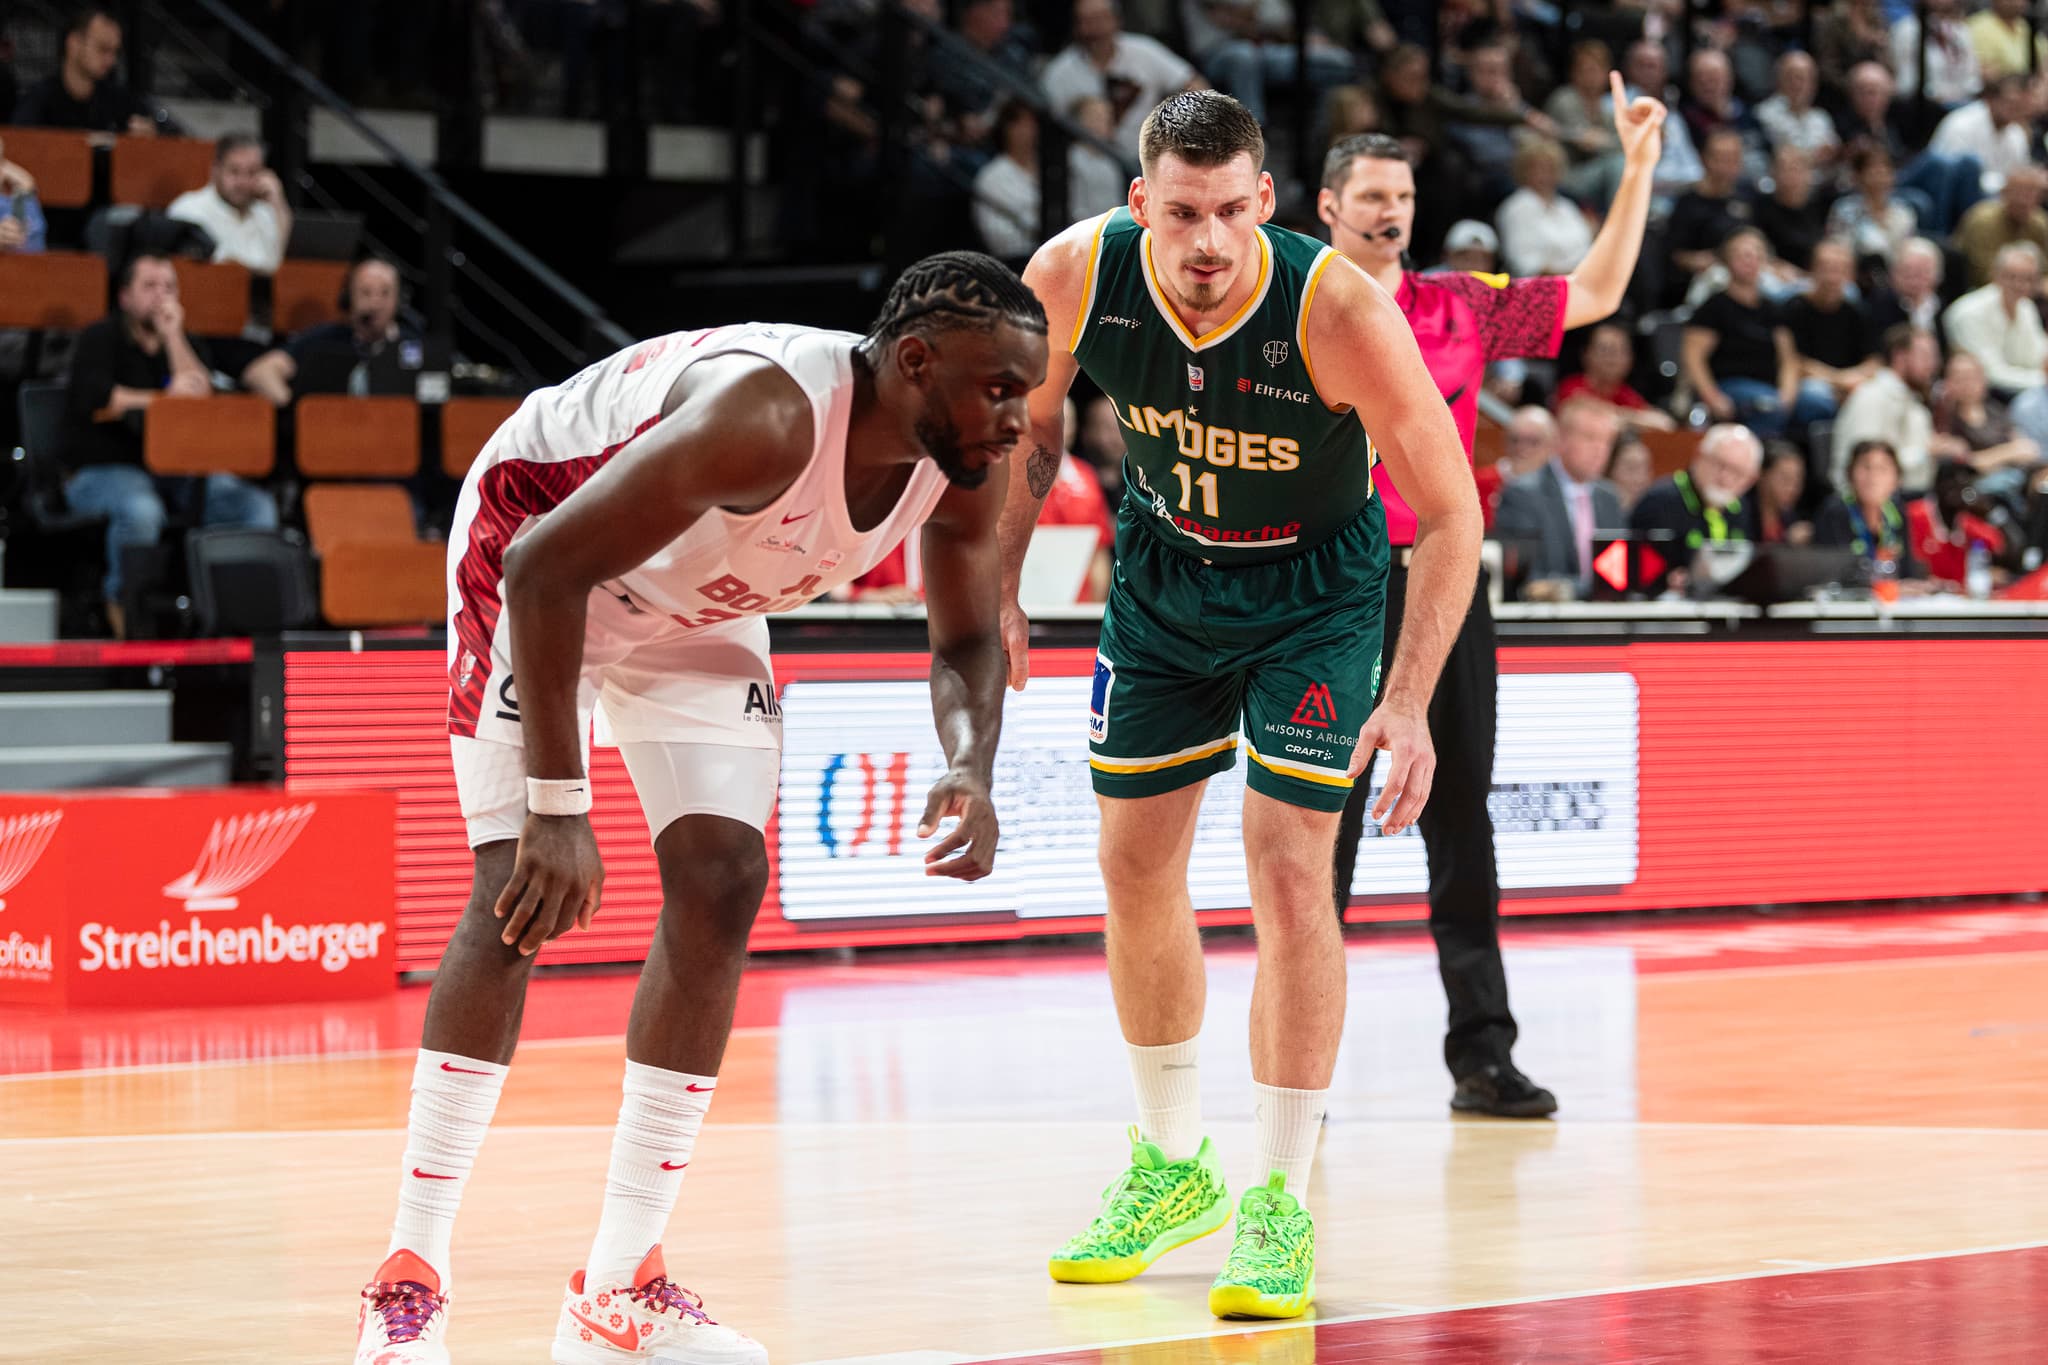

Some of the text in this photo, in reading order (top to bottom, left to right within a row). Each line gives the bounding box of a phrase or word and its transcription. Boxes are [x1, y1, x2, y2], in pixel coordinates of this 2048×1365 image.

[1099, 315, 1131, 328] CRAFT
[1254, 383, 1311, 404] EIFFAGE
[1171, 461, 1220, 519] 11
[1285, 743, 1325, 759] CRAFT
[79, 913, 386, 973] Streichenberger
